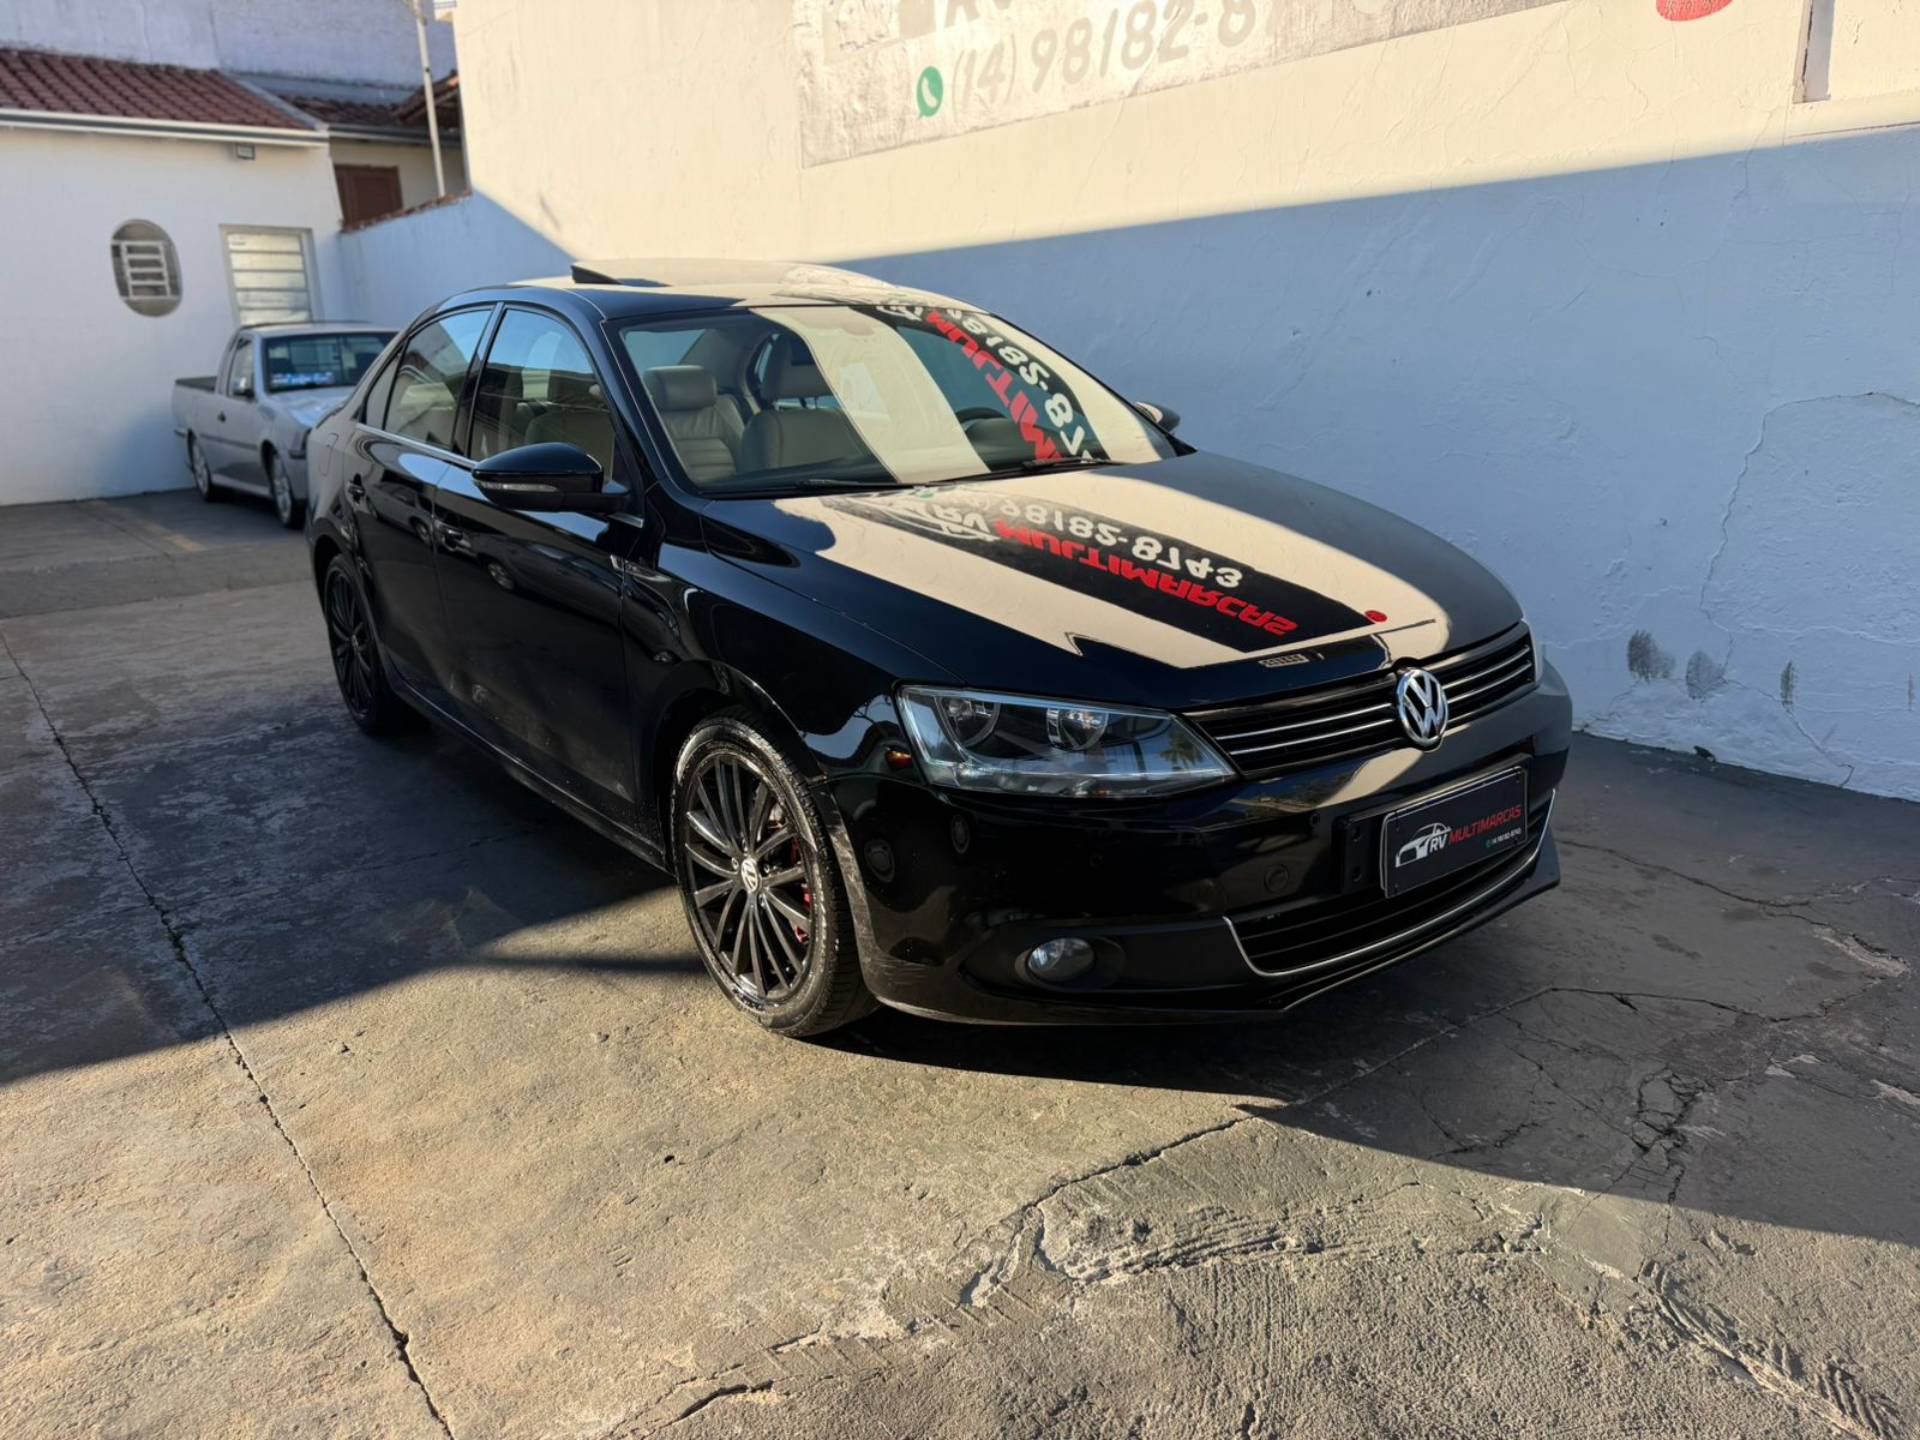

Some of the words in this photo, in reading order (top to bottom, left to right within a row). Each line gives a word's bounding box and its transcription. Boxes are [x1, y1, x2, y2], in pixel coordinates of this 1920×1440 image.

[952, 32, 1017, 111] (14)
[1429, 833, 1449, 853] RV
[1448, 804, 1522, 845] MULTIMARCAS
